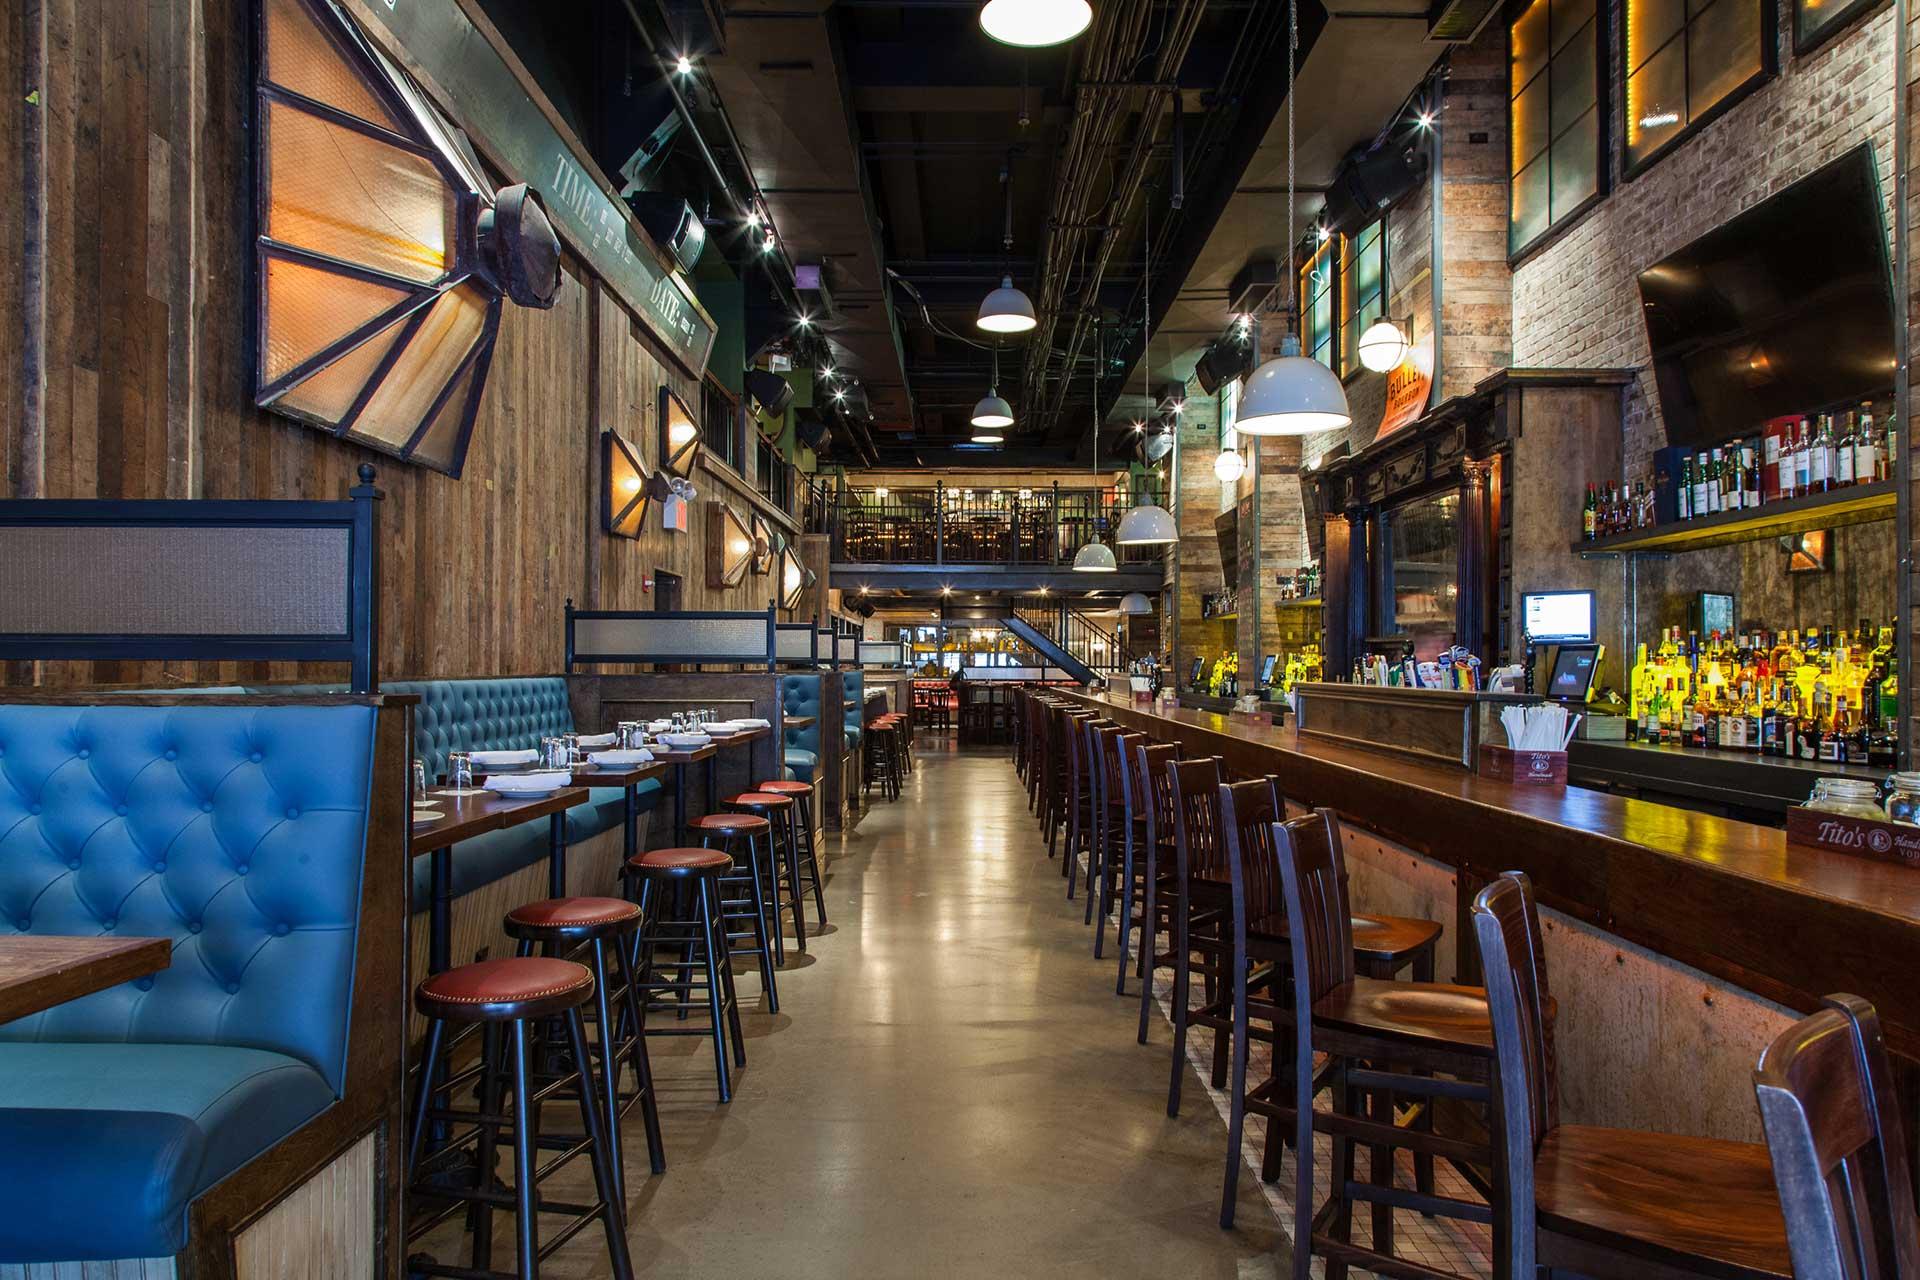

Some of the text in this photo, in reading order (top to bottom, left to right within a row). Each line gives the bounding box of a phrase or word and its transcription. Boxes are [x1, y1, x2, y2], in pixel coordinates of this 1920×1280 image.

[552, 153, 597, 231] TIME:
[650, 277, 680, 328] DATE:
[1531, 752, 1550, 760] Tito's
[1817, 821, 1865, 848] Tito's
